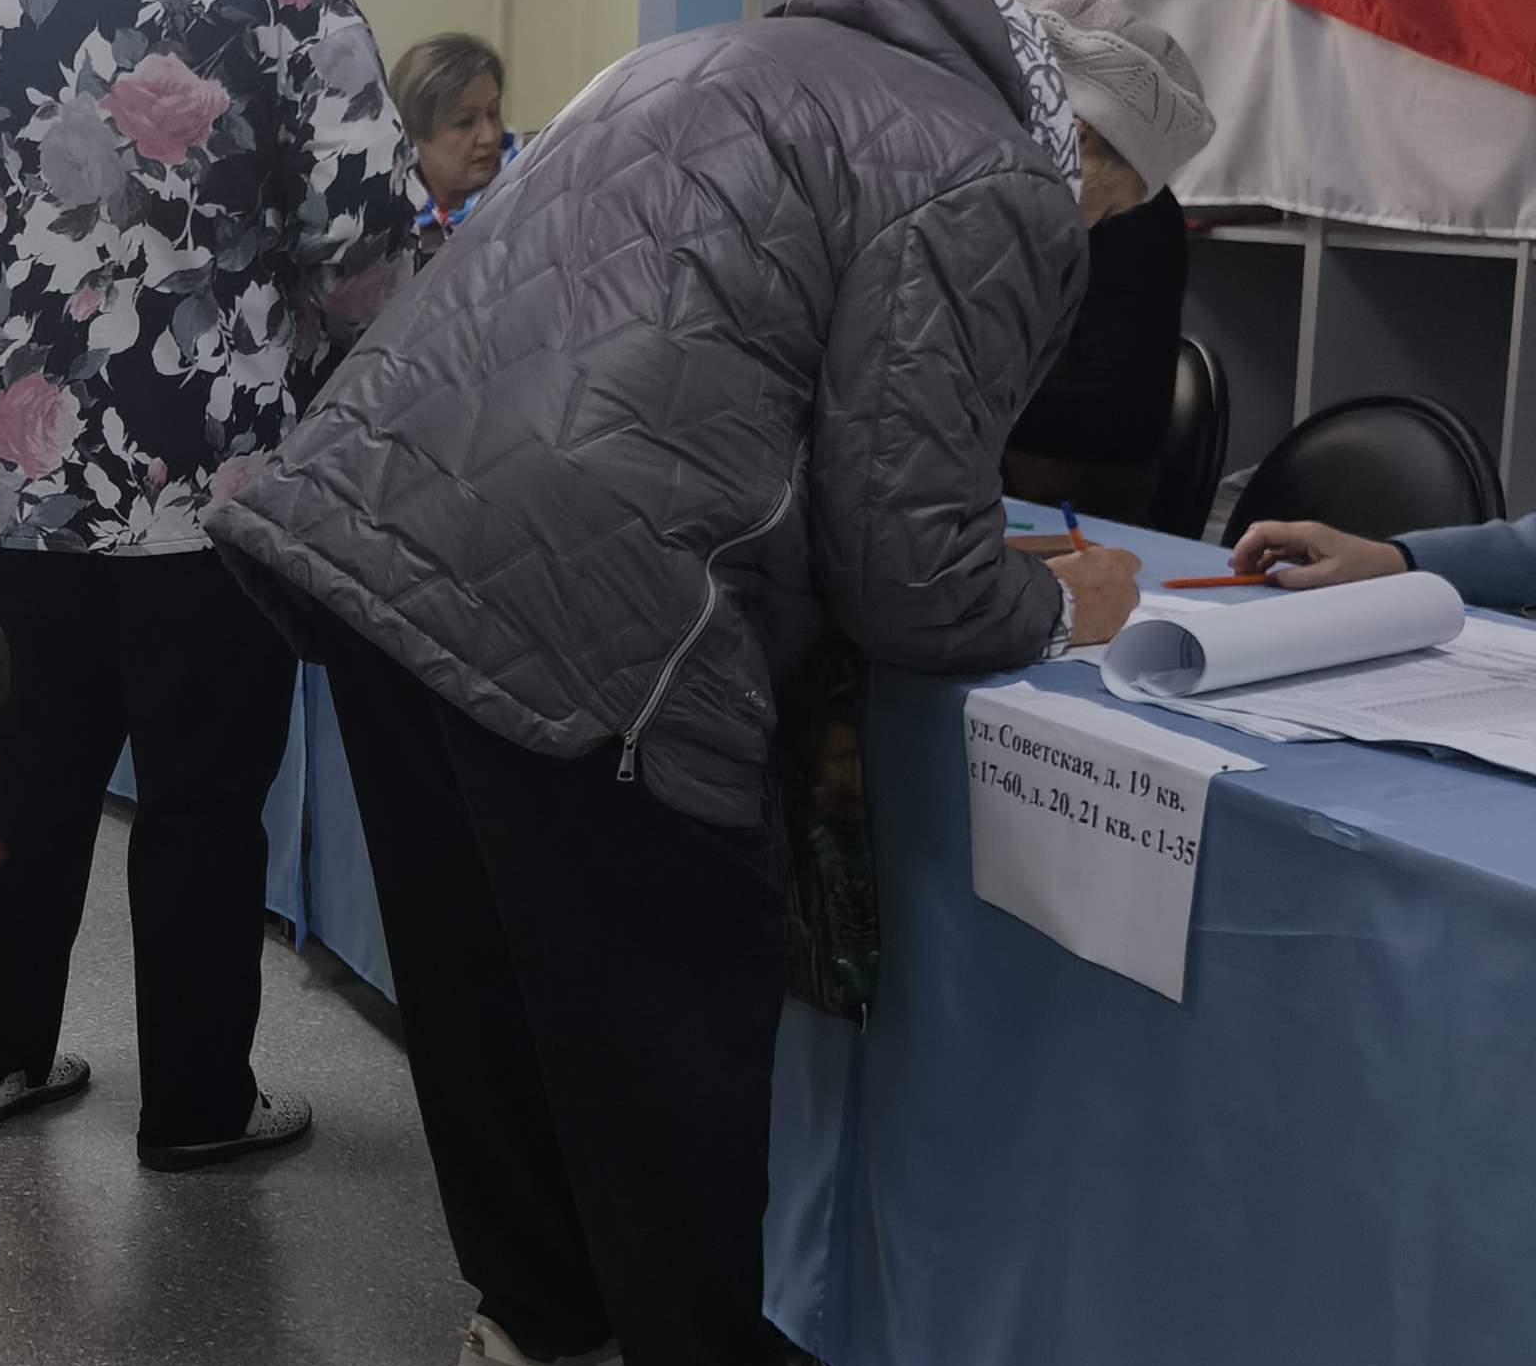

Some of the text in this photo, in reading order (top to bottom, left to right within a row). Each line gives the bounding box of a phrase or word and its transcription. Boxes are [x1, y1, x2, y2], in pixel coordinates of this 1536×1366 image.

[968, 718, 1186, 813] ул. Советская, д. 19 кв.
[969, 760, 1197, 866] с 17-60, д. 20, 21 кв. с 1-35
